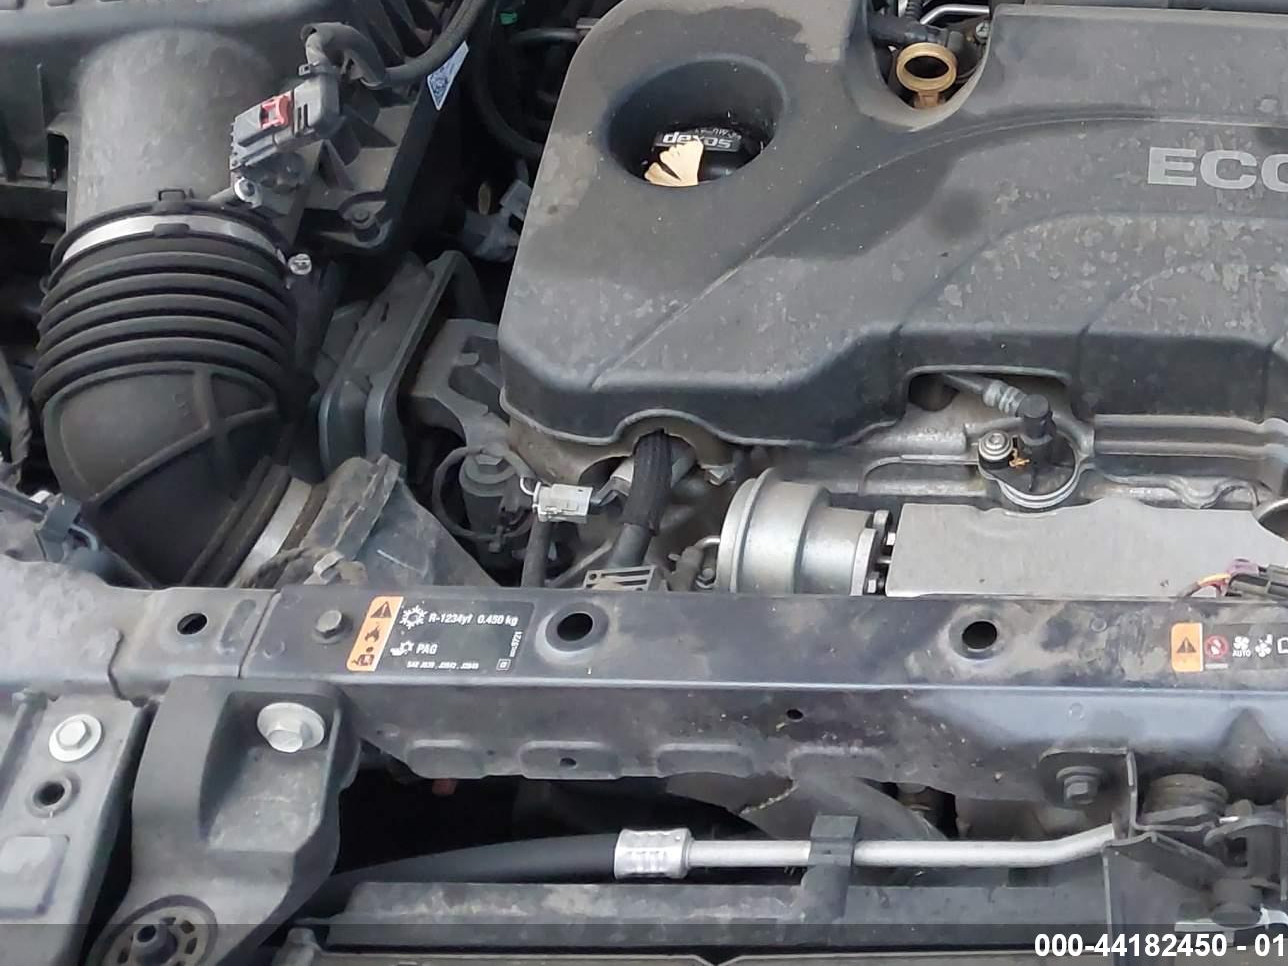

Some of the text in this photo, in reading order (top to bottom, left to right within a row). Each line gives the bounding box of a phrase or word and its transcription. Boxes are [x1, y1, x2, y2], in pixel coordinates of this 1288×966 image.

[428, 612, 519, 627] R-1234yf 0.450 kg
[416, 642, 438, 655] PAG
[1232, 649, 1251, 658] AUTO
